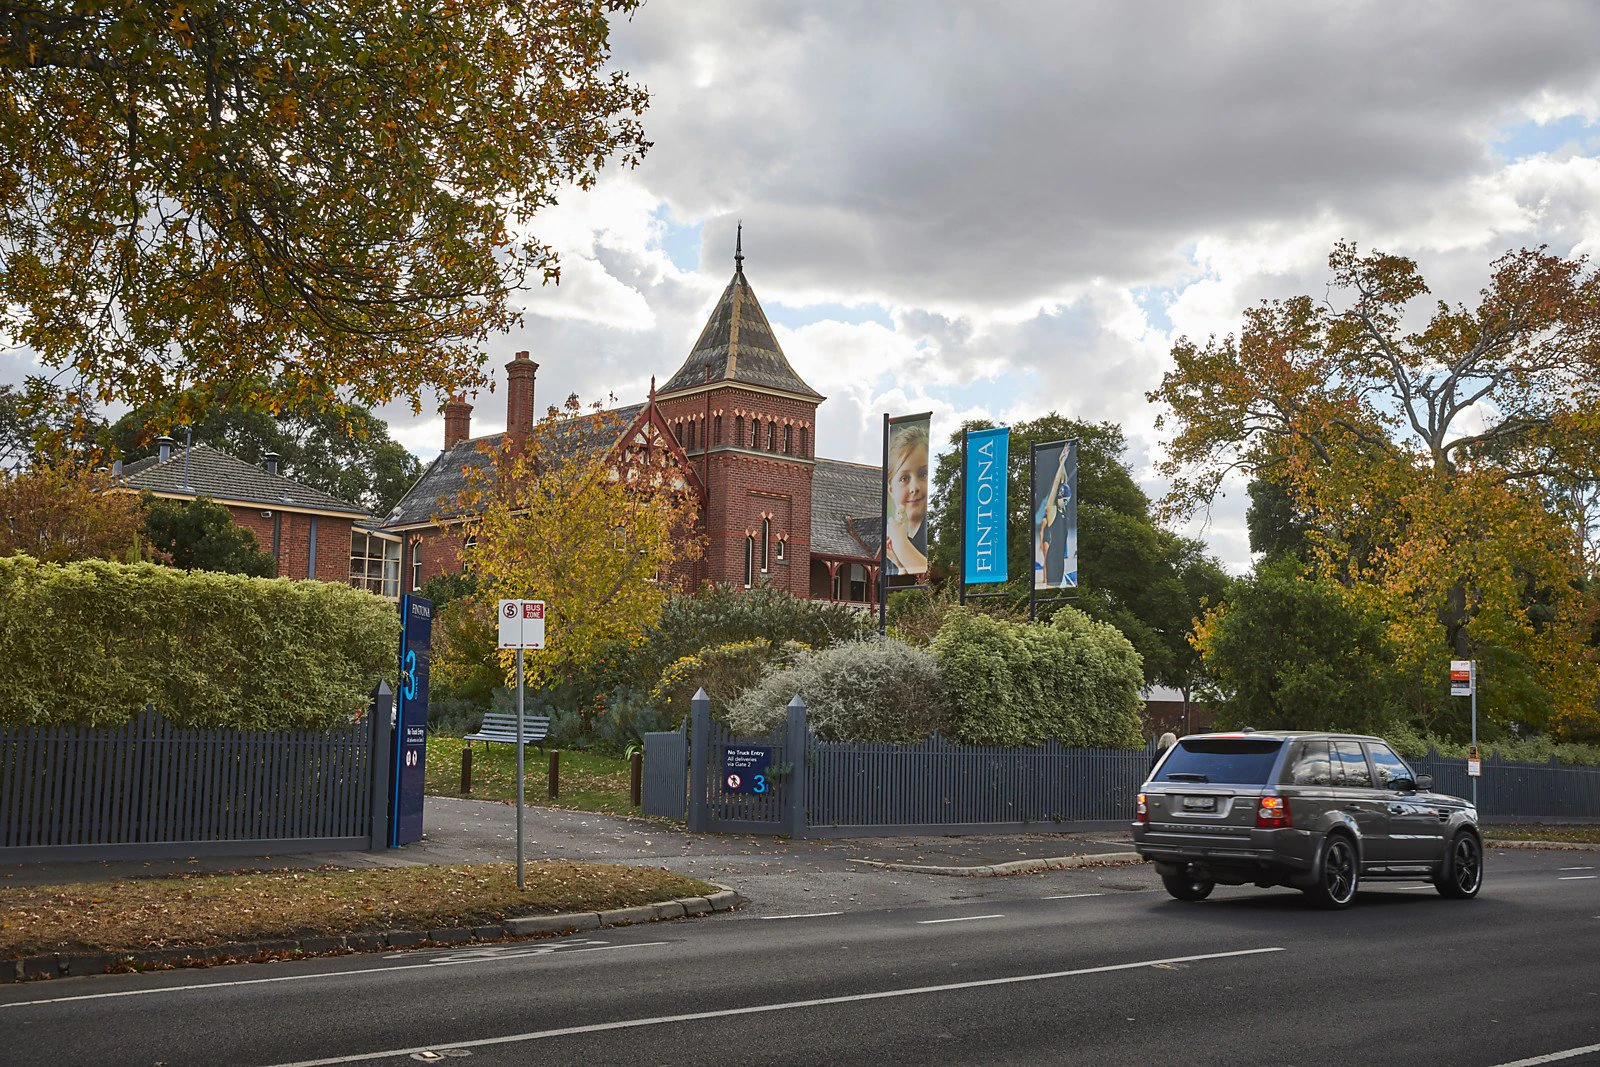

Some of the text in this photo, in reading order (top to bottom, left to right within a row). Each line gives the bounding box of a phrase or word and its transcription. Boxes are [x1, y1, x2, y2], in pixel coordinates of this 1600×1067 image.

[976, 439, 993, 572] FINTONA
[526, 611, 541, 619] ZONE
[403, 650, 416, 700] 3
[754, 774, 766, 792] 3
